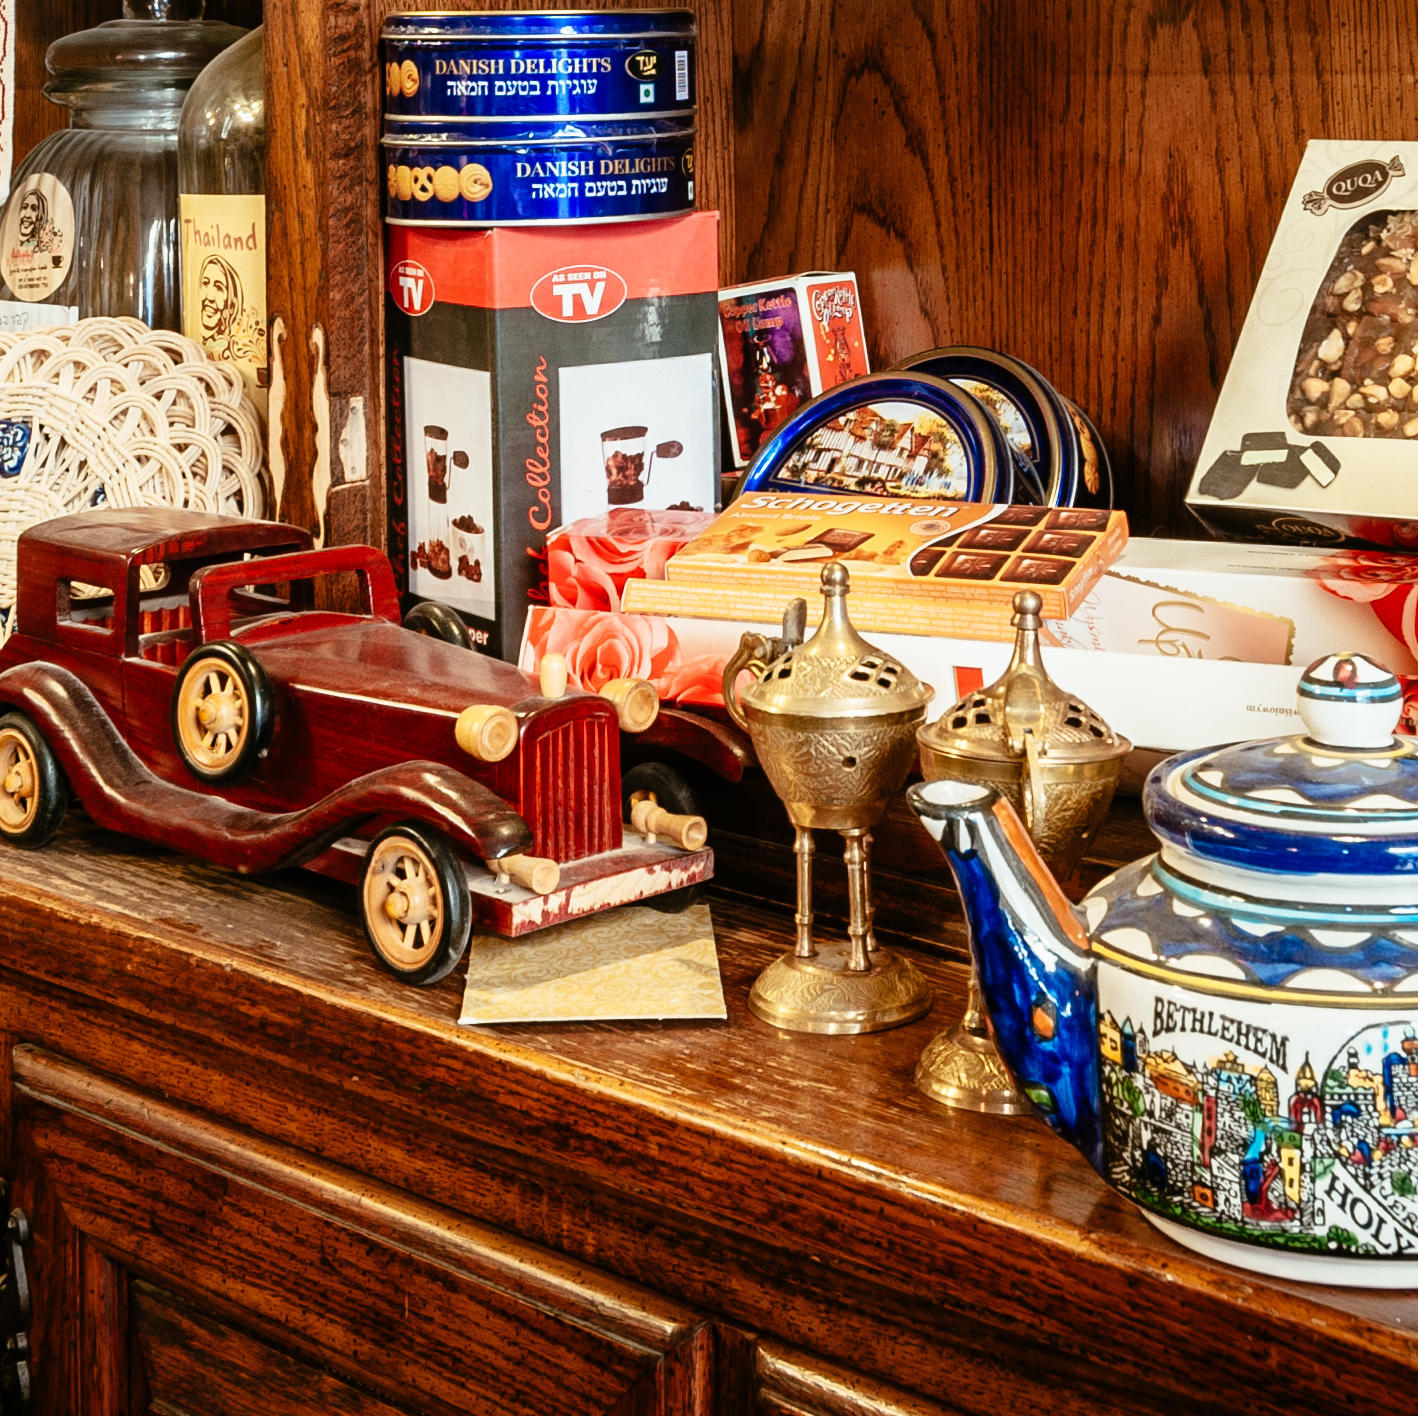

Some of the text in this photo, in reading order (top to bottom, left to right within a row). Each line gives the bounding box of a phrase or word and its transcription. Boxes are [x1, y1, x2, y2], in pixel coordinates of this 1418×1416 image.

[434, 56, 612, 76] DANISH DELIGHTS
[446, 79, 598, 97] עוגיות בטעם חמאה
[516, 159, 595, 178] DANISH
[599, 155, 676, 176] DELIGHTS
[531, 177, 669, 199] עוגיות בטעם חמאה
[1331, 167, 1384, 197] QUQA
[183, 218, 258, 252] Thailand
[552, 270, 607, 283] AS SEEN ON
[398, 276, 424, 311] TV
[552, 281, 606, 317] TV
[722, 302, 758, 319] Copper
[735, 316, 784, 334] Oil Lamp
[525, 355, 552, 531] Collection
[739, 495, 961, 518] Schogetten
[1151, 995, 1291, 1076] BETHLEHEM
[1322, 1170, 1415, 1256] HOLY
